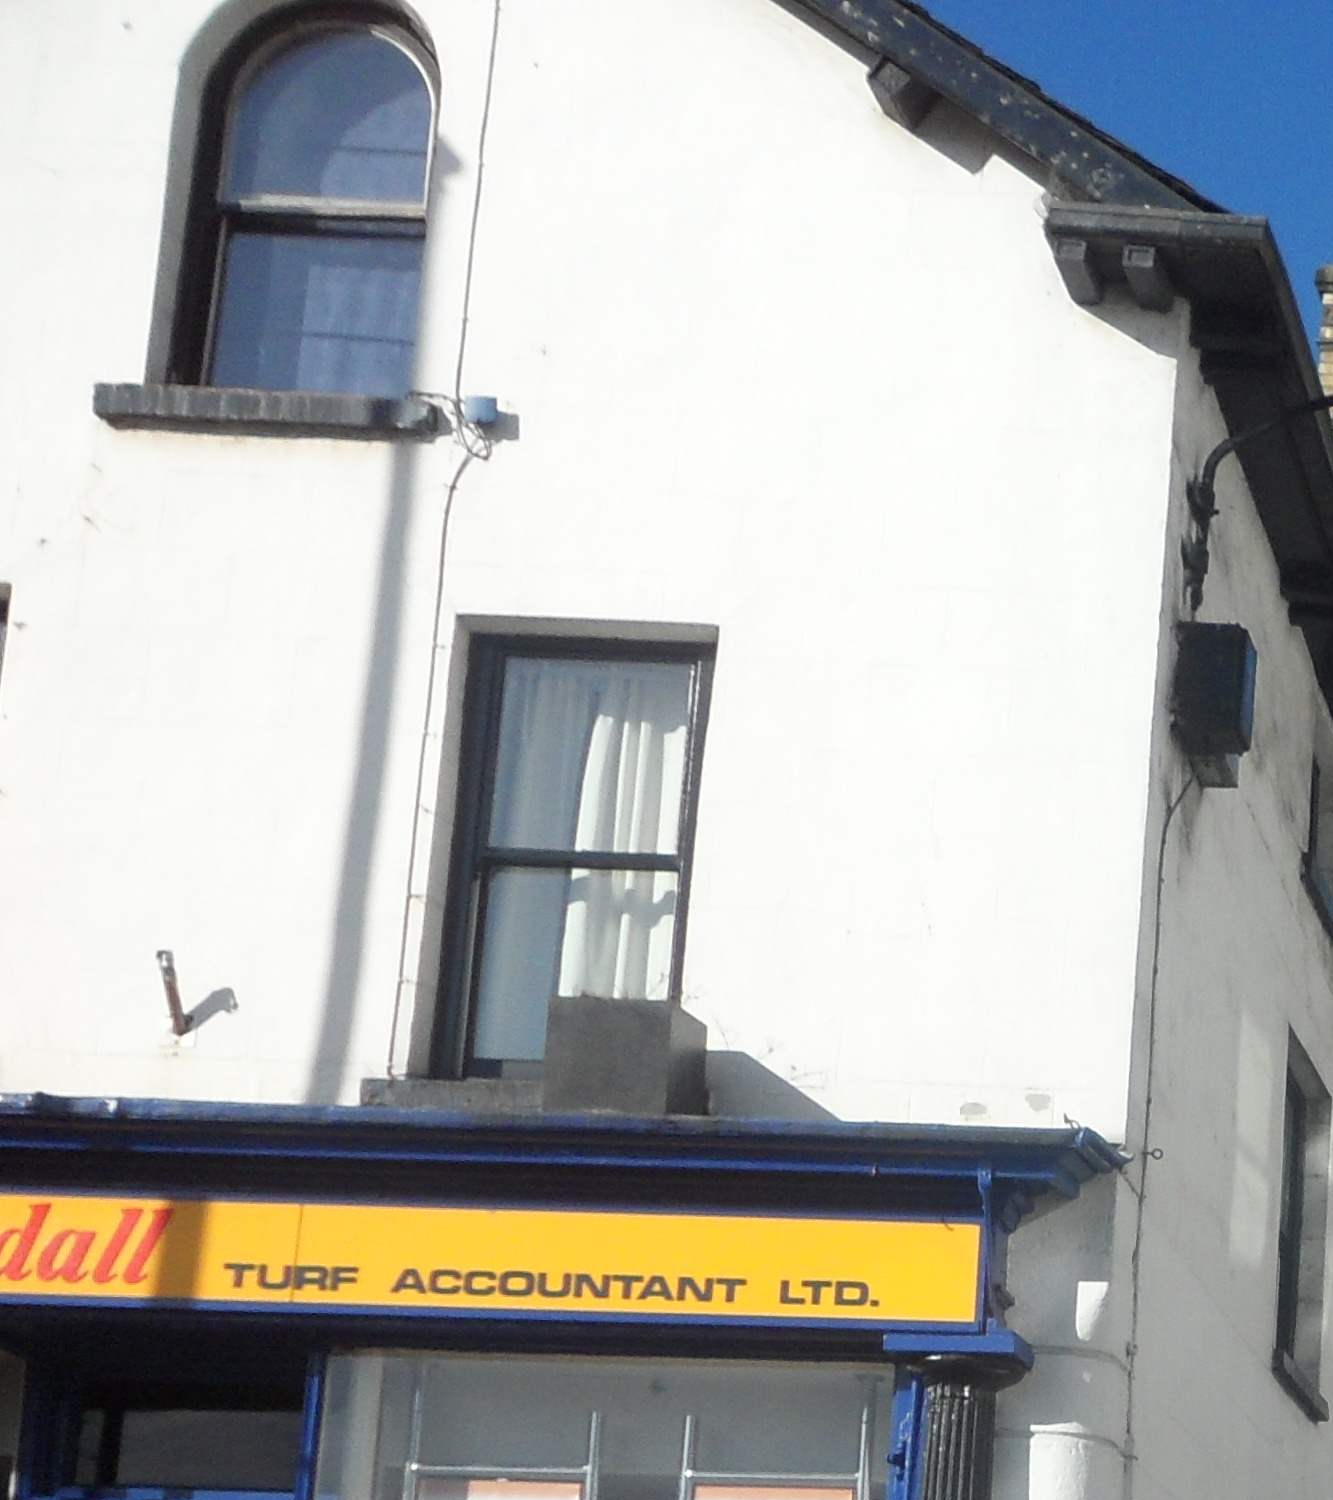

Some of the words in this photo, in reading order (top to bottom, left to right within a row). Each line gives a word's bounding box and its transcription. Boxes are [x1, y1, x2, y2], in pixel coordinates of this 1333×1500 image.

[223, 1262, 360, 1293] TURF
[390, 1268, 748, 1303] ACCOUNTANT
[778, 1279, 880, 1307] LTD.
